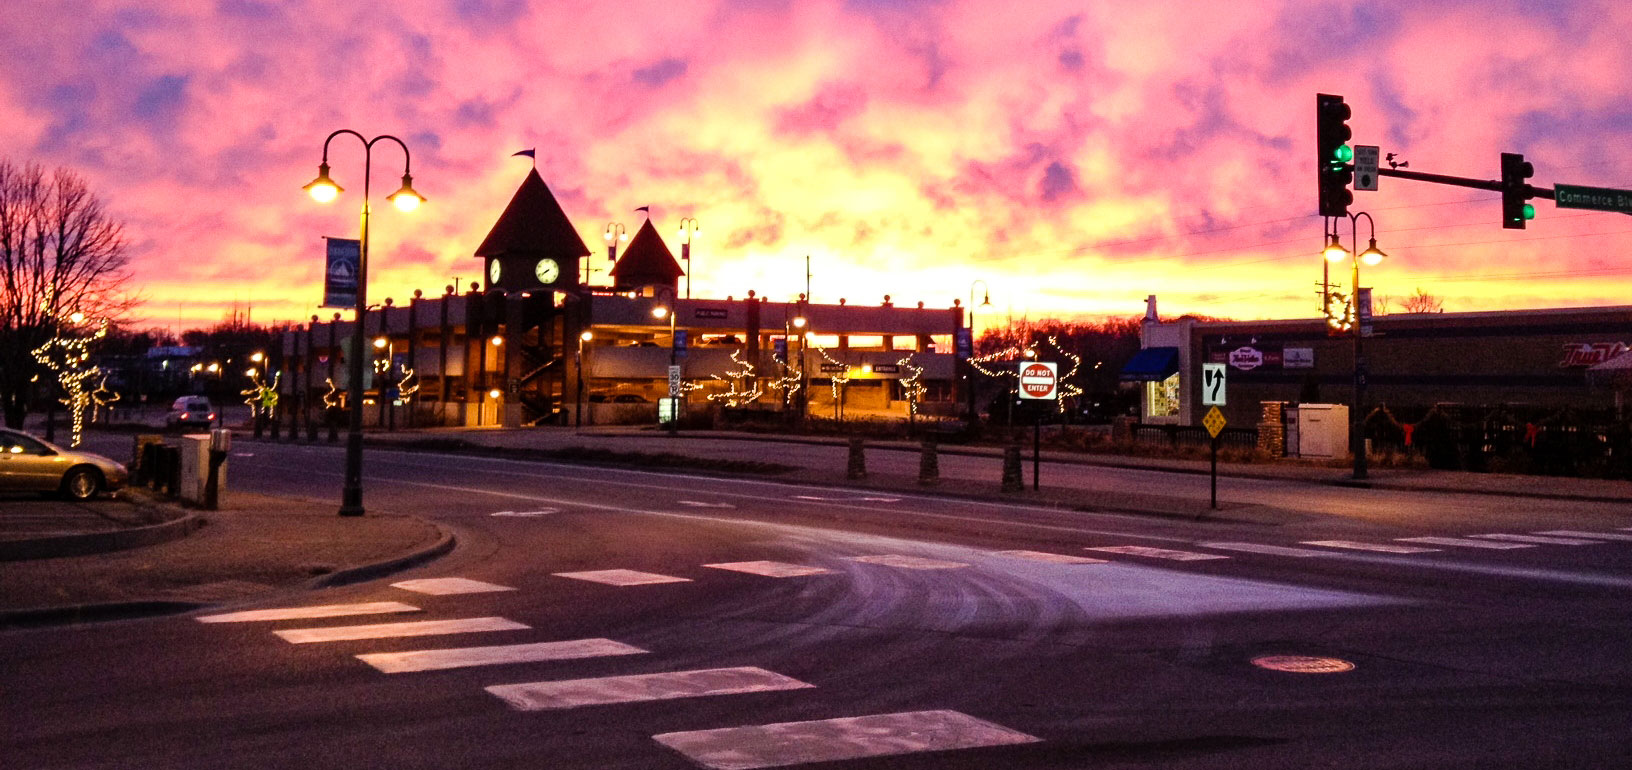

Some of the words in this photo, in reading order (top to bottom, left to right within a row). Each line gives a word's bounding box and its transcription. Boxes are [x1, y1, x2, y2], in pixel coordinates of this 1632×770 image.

[1559, 190, 1613, 206] Commerce
[1025, 369, 1035, 377] DO
[1037, 369, 1051, 377] NOT
[1027, 384, 1048, 392] ENTER
